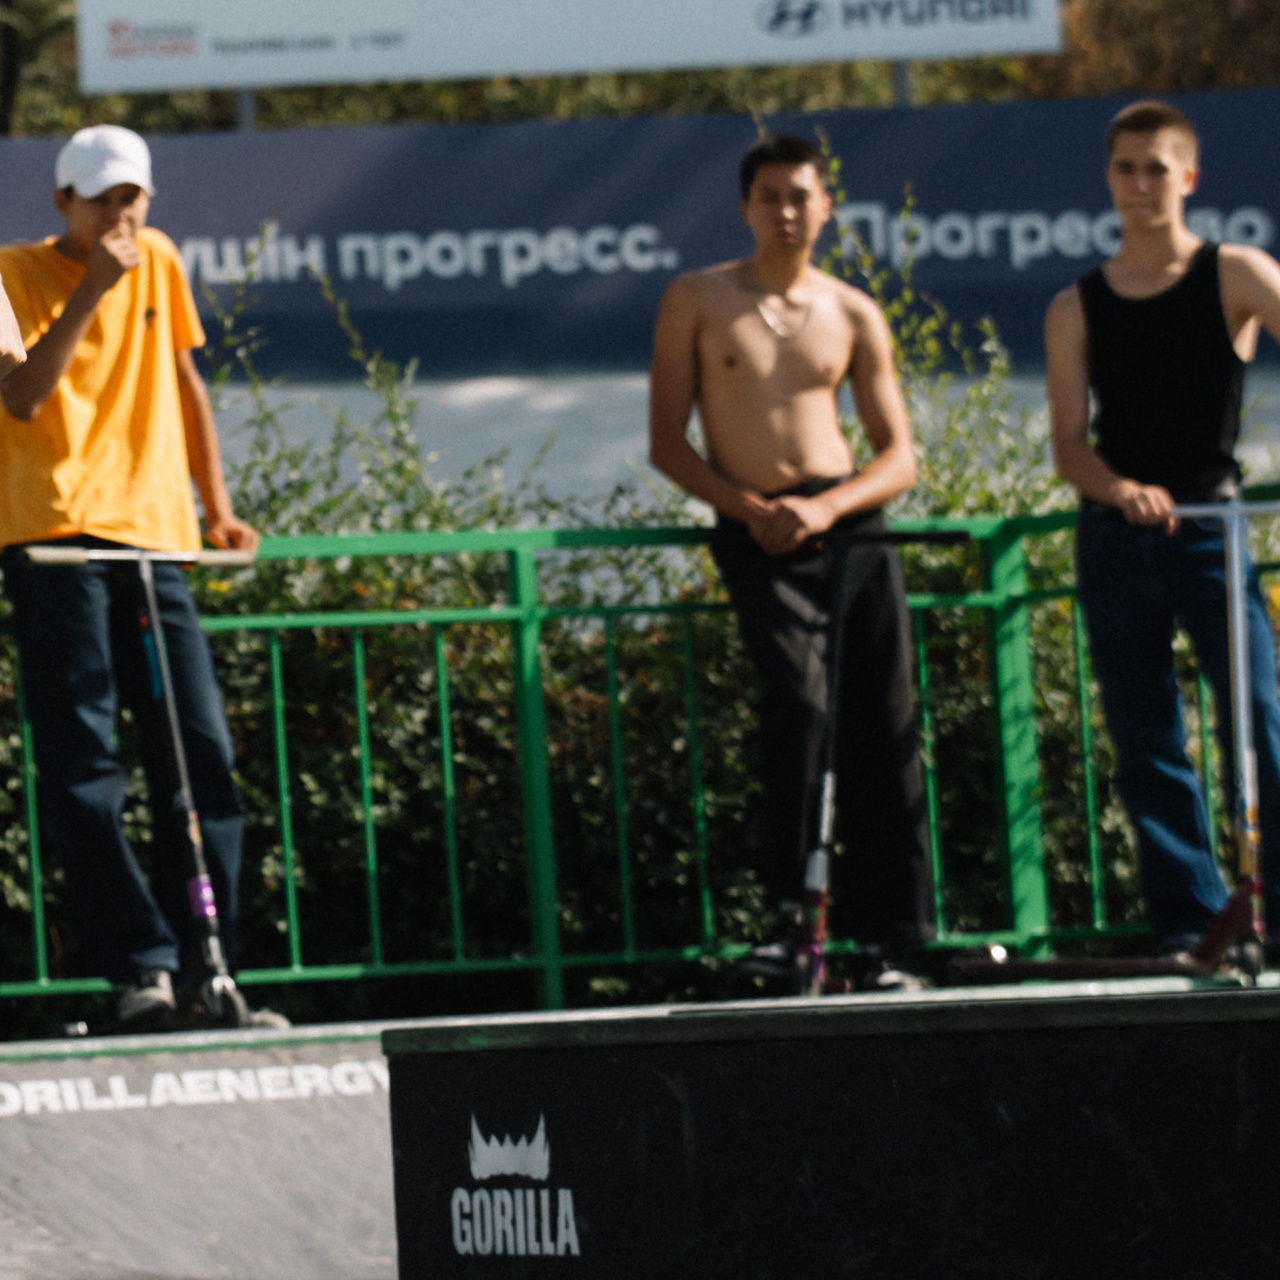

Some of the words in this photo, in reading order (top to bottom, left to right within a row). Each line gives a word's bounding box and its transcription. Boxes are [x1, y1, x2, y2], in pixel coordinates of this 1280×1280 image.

[336, 224, 680, 291] прогресс.
[839, 200, 1123, 271] Прогрес
[451, 1187, 581, 1256] GORILLA
